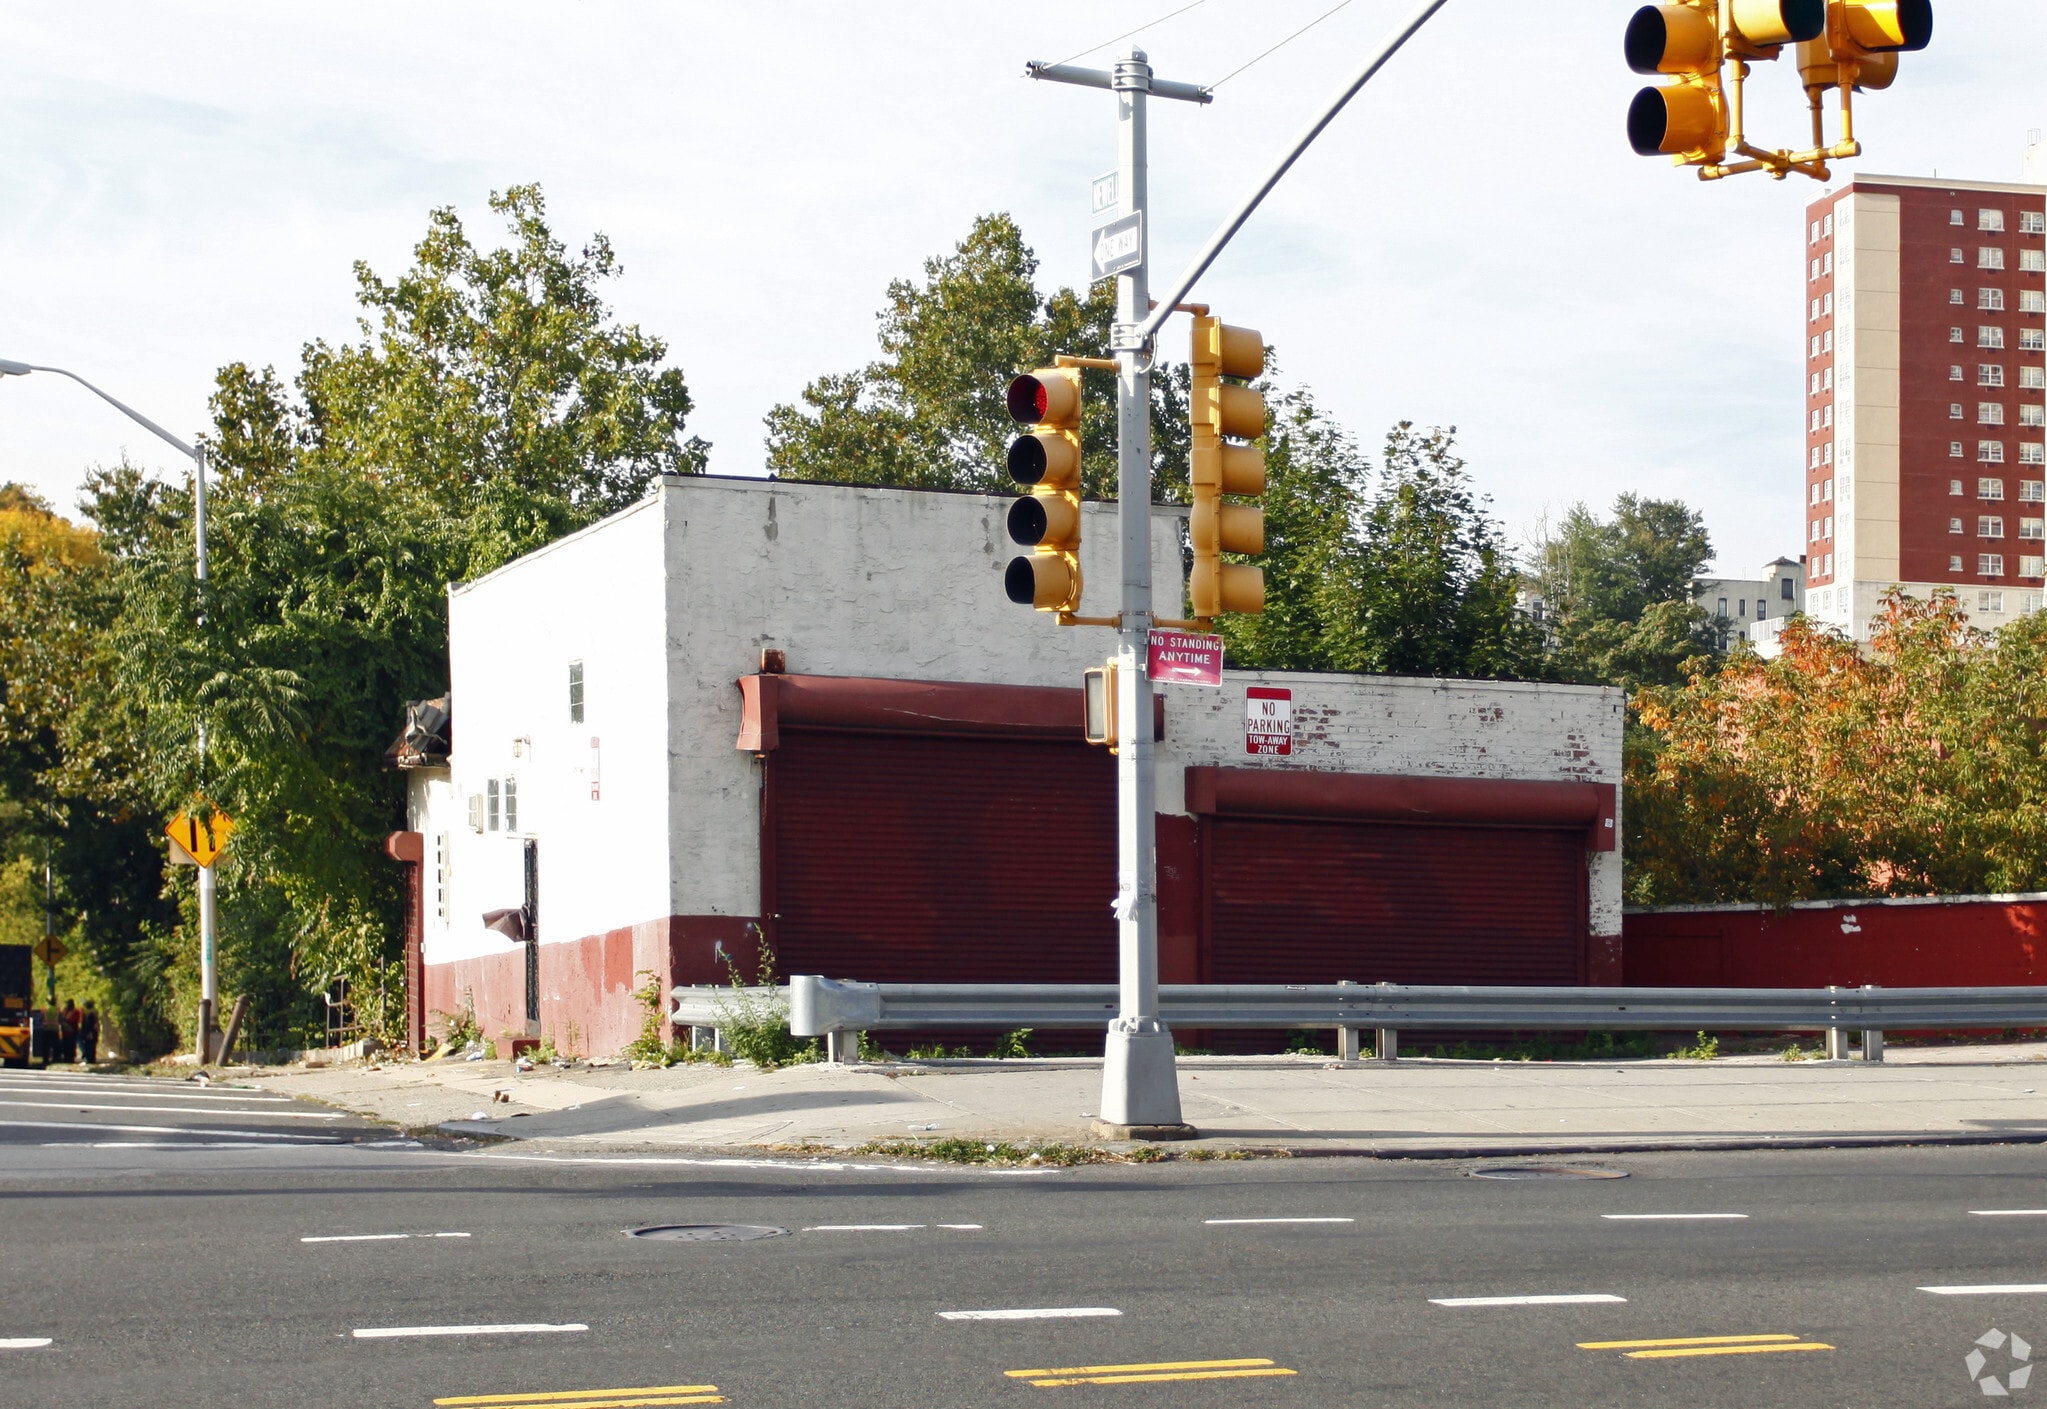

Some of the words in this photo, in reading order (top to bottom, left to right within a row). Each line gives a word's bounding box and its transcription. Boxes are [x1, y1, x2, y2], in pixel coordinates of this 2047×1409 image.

[1100, 238, 1114, 261] ONE
[1119, 232, 1133, 253] WAY
[1151, 635, 1165, 646] NO
[1170, 637, 1220, 651] STANDING
[1158, 650, 1211, 665] ANYTIME
[1262, 701, 1276, 716] NO
[1248, 718, 1290, 734] PARKING
[1249, 734, 1288, 744] TOW-AWAY
[1257, 745, 1279, 755] ZONE
